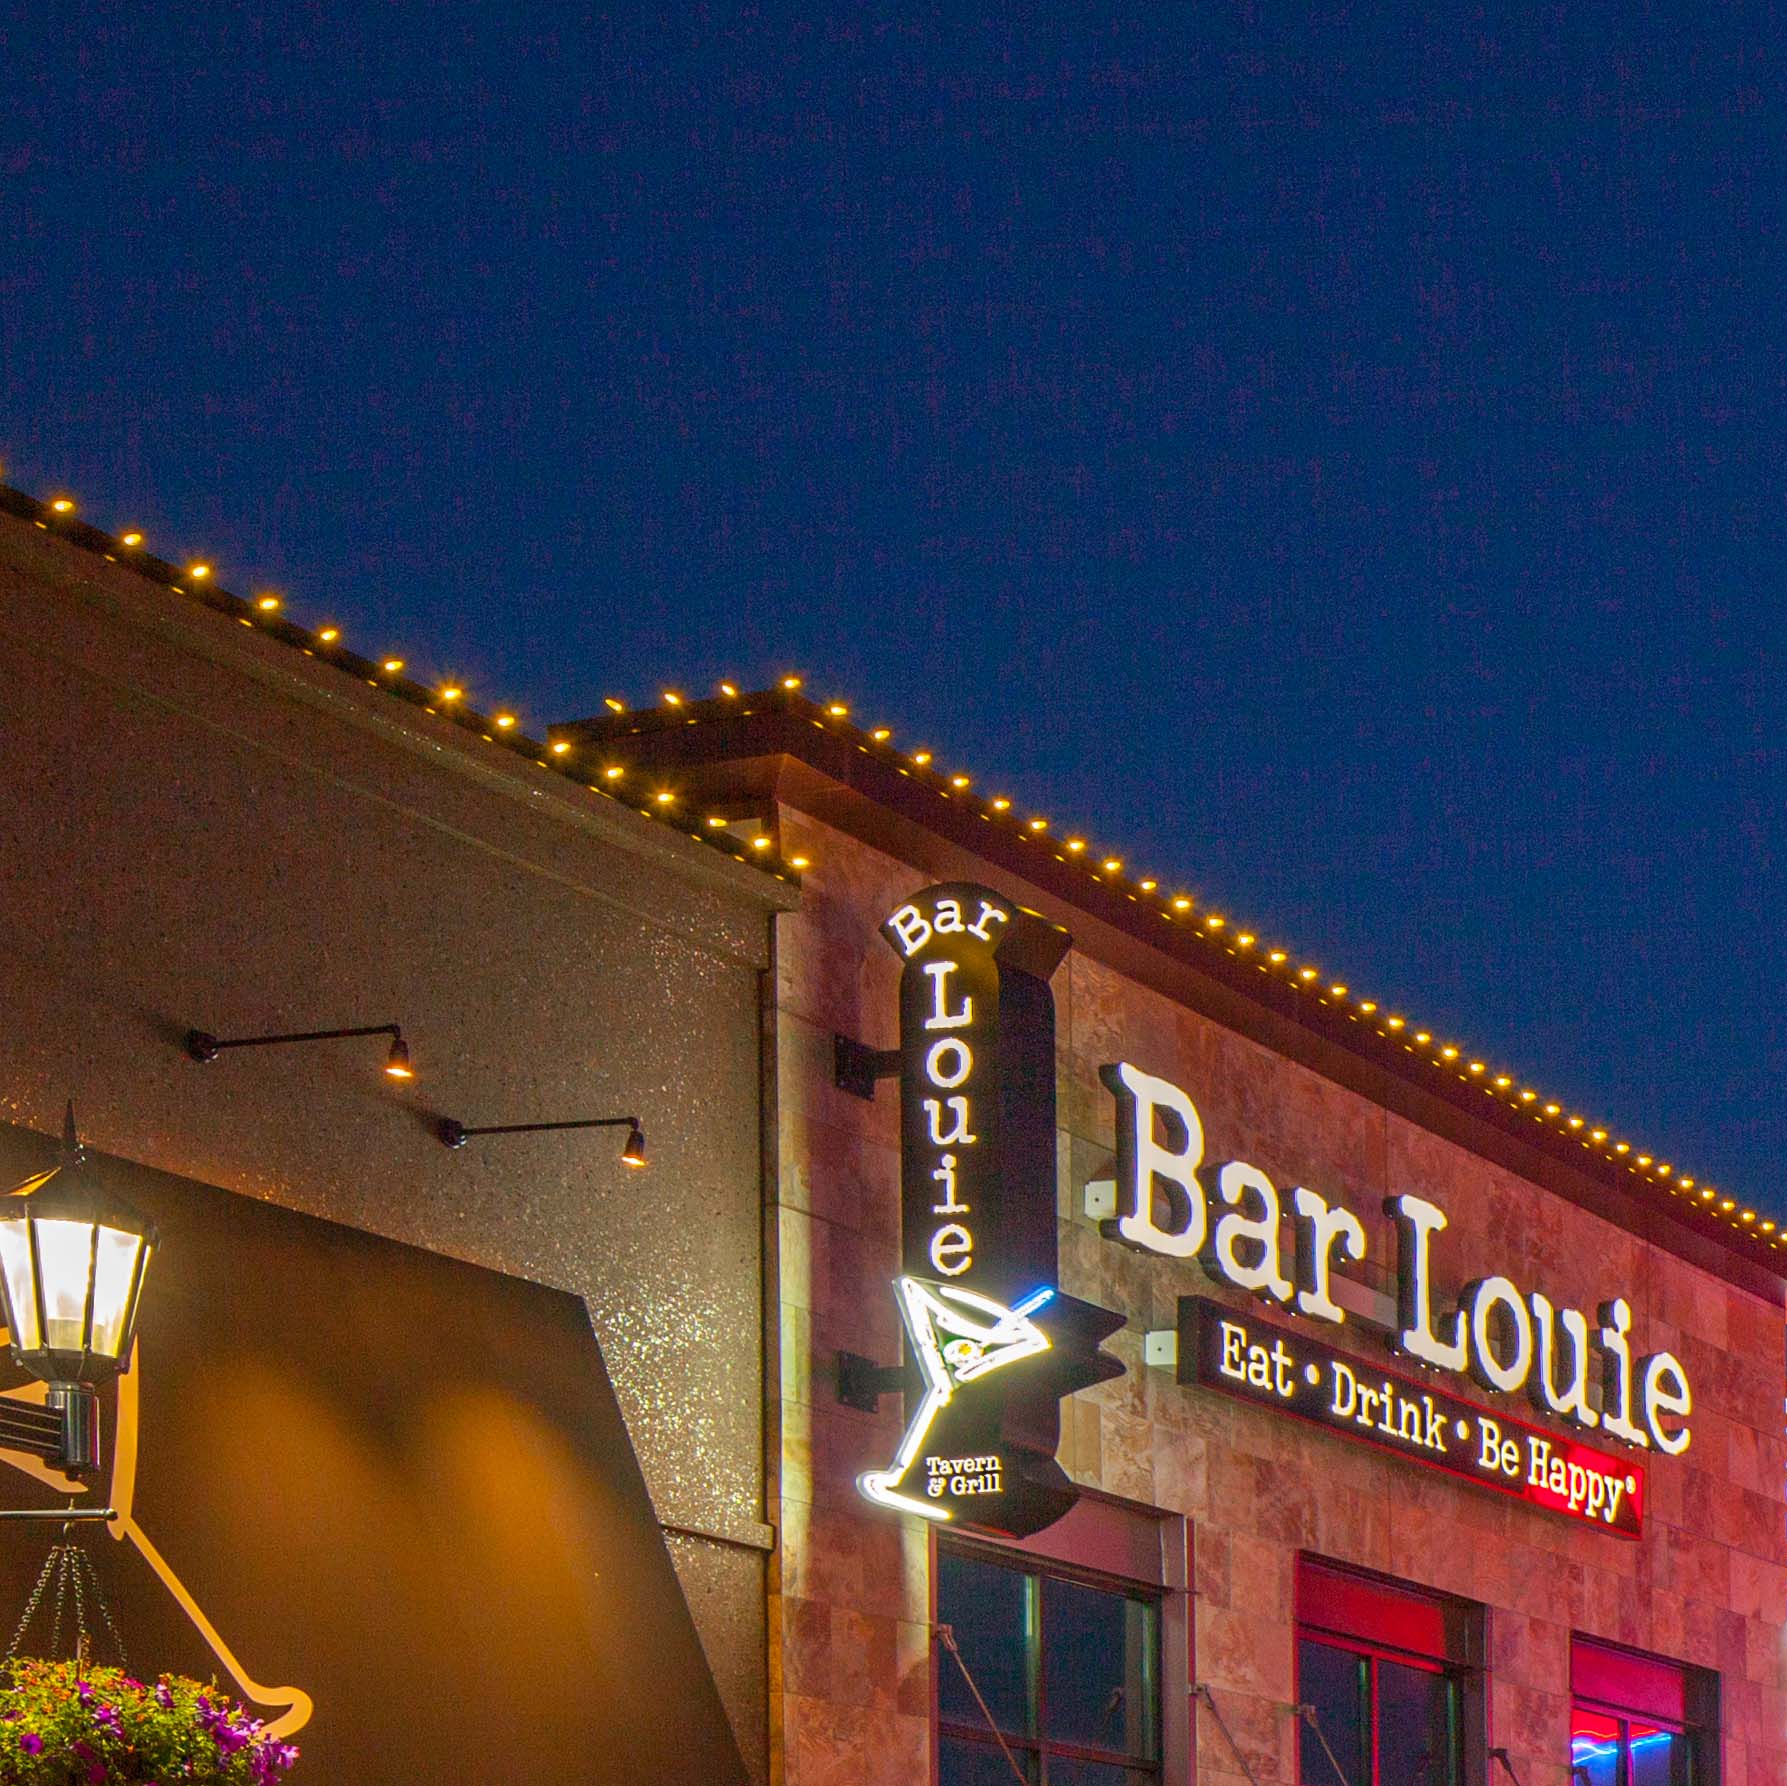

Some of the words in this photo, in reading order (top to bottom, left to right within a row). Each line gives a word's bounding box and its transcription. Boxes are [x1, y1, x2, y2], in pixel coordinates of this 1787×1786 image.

[888, 899, 1008, 957] Bar
[923, 961, 976, 1276] Louie
[1119, 1061, 1367, 1324] Bar
[1400, 1194, 1693, 1456] Louie
[1220, 1320, 1295, 1398] Eat
[1331, 1361, 1447, 1453] Drink
[1478, 1417, 1520, 1476] Be
[926, 1456, 1001, 1476] Tavern
[928, 1477, 947, 1497] &
[950, 1473, 1002, 1496] Grill
